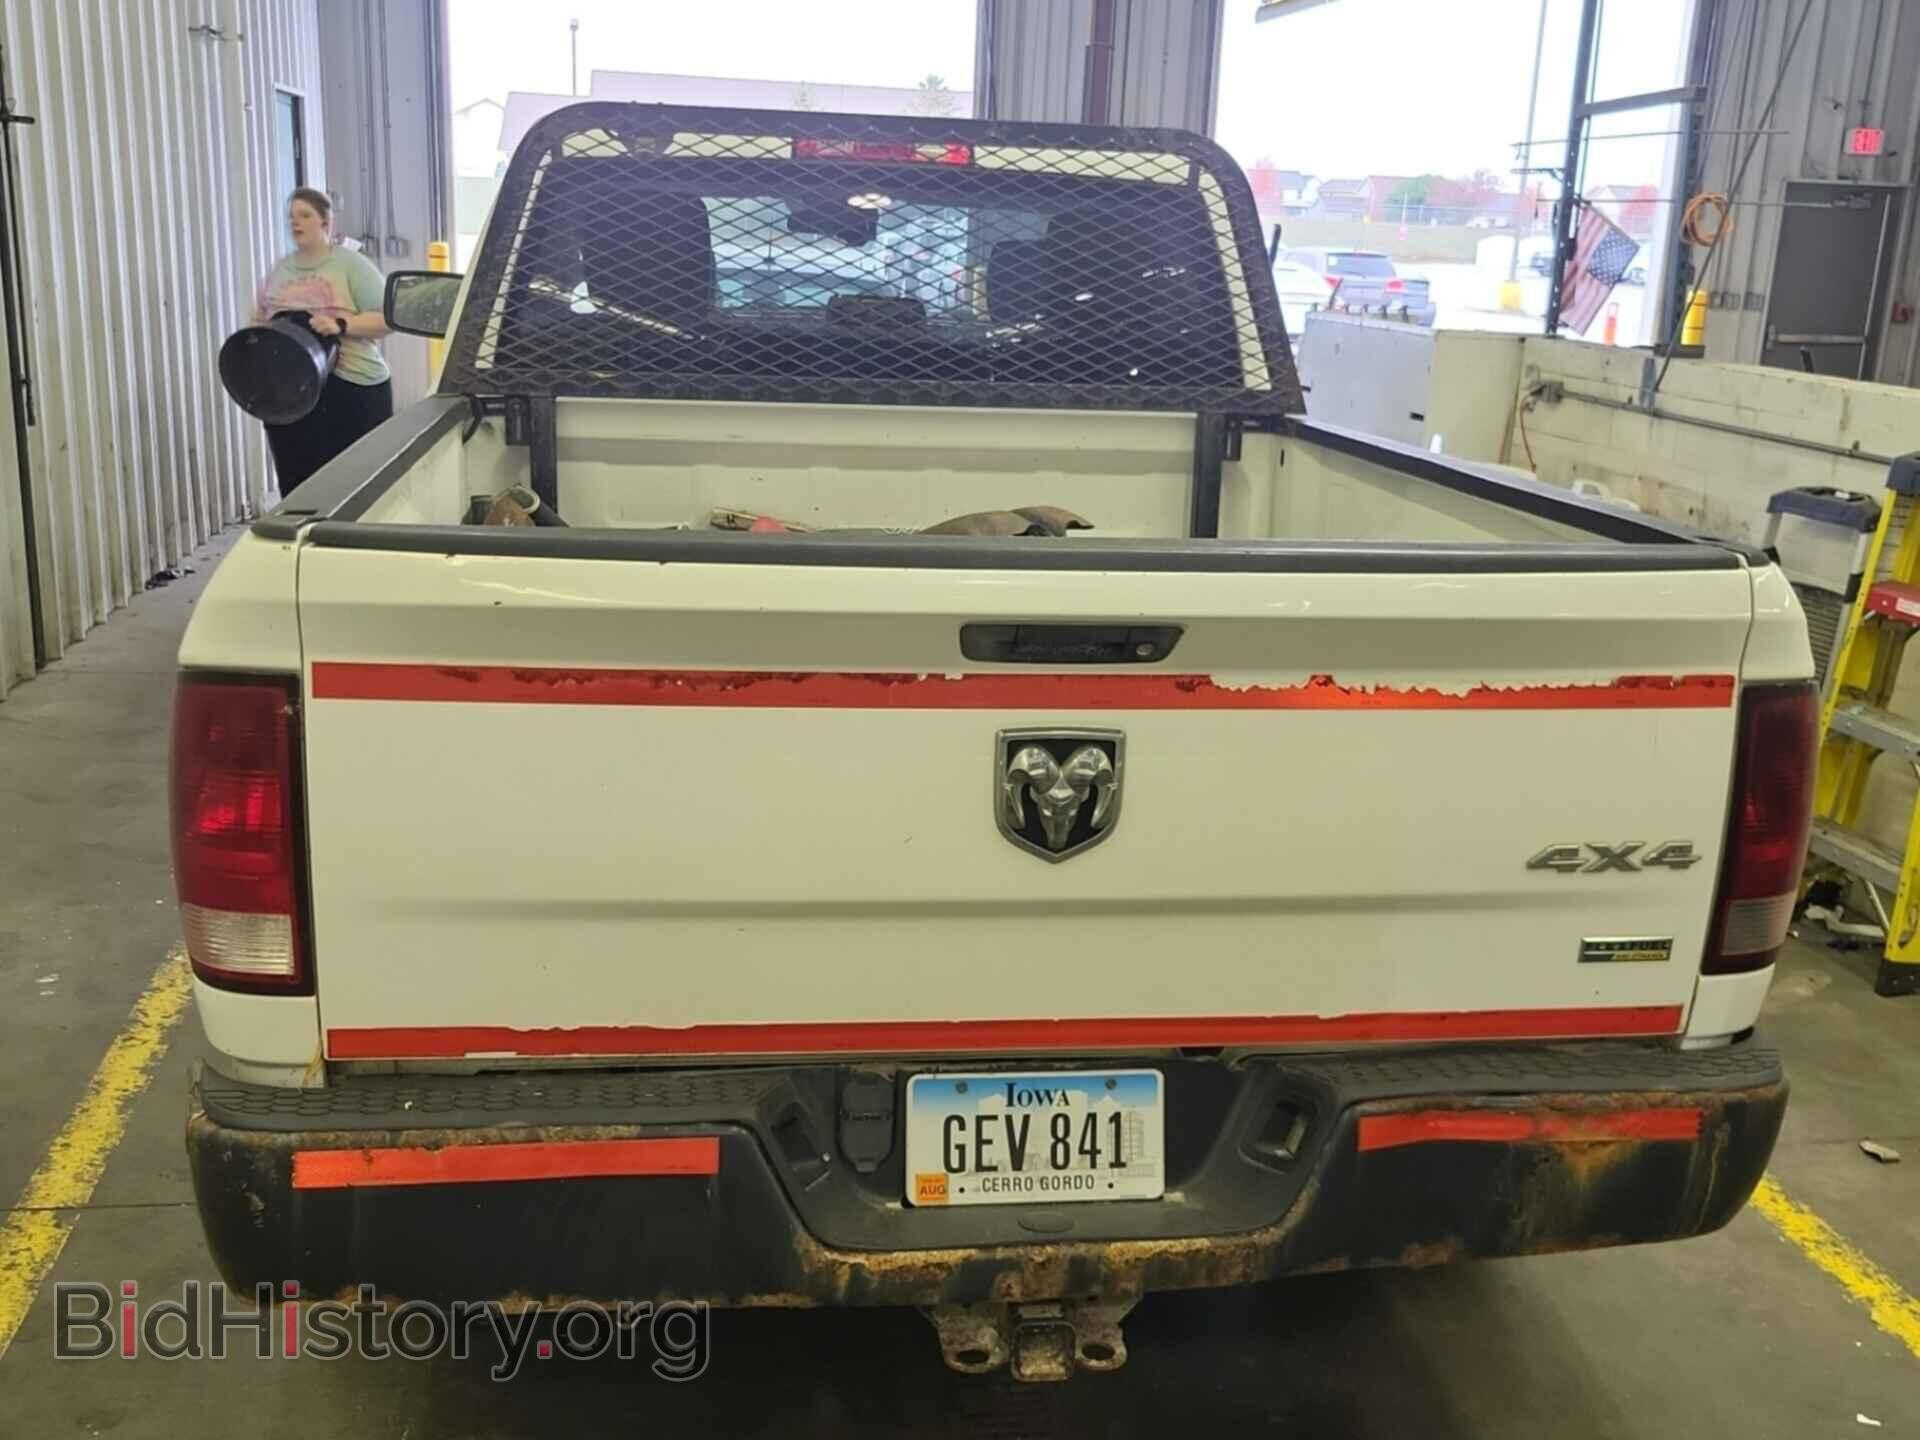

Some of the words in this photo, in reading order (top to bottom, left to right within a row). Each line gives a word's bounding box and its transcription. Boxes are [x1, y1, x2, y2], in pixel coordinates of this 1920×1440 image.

[943, 1113, 1030, 1174] GEV
[1050, 1111, 1127, 1170] 841
[919, 1185, 947, 1197] AUG
[982, 1177, 1034, 1193] CERRO
[1039, 1174, 1095, 1191] GORDO
